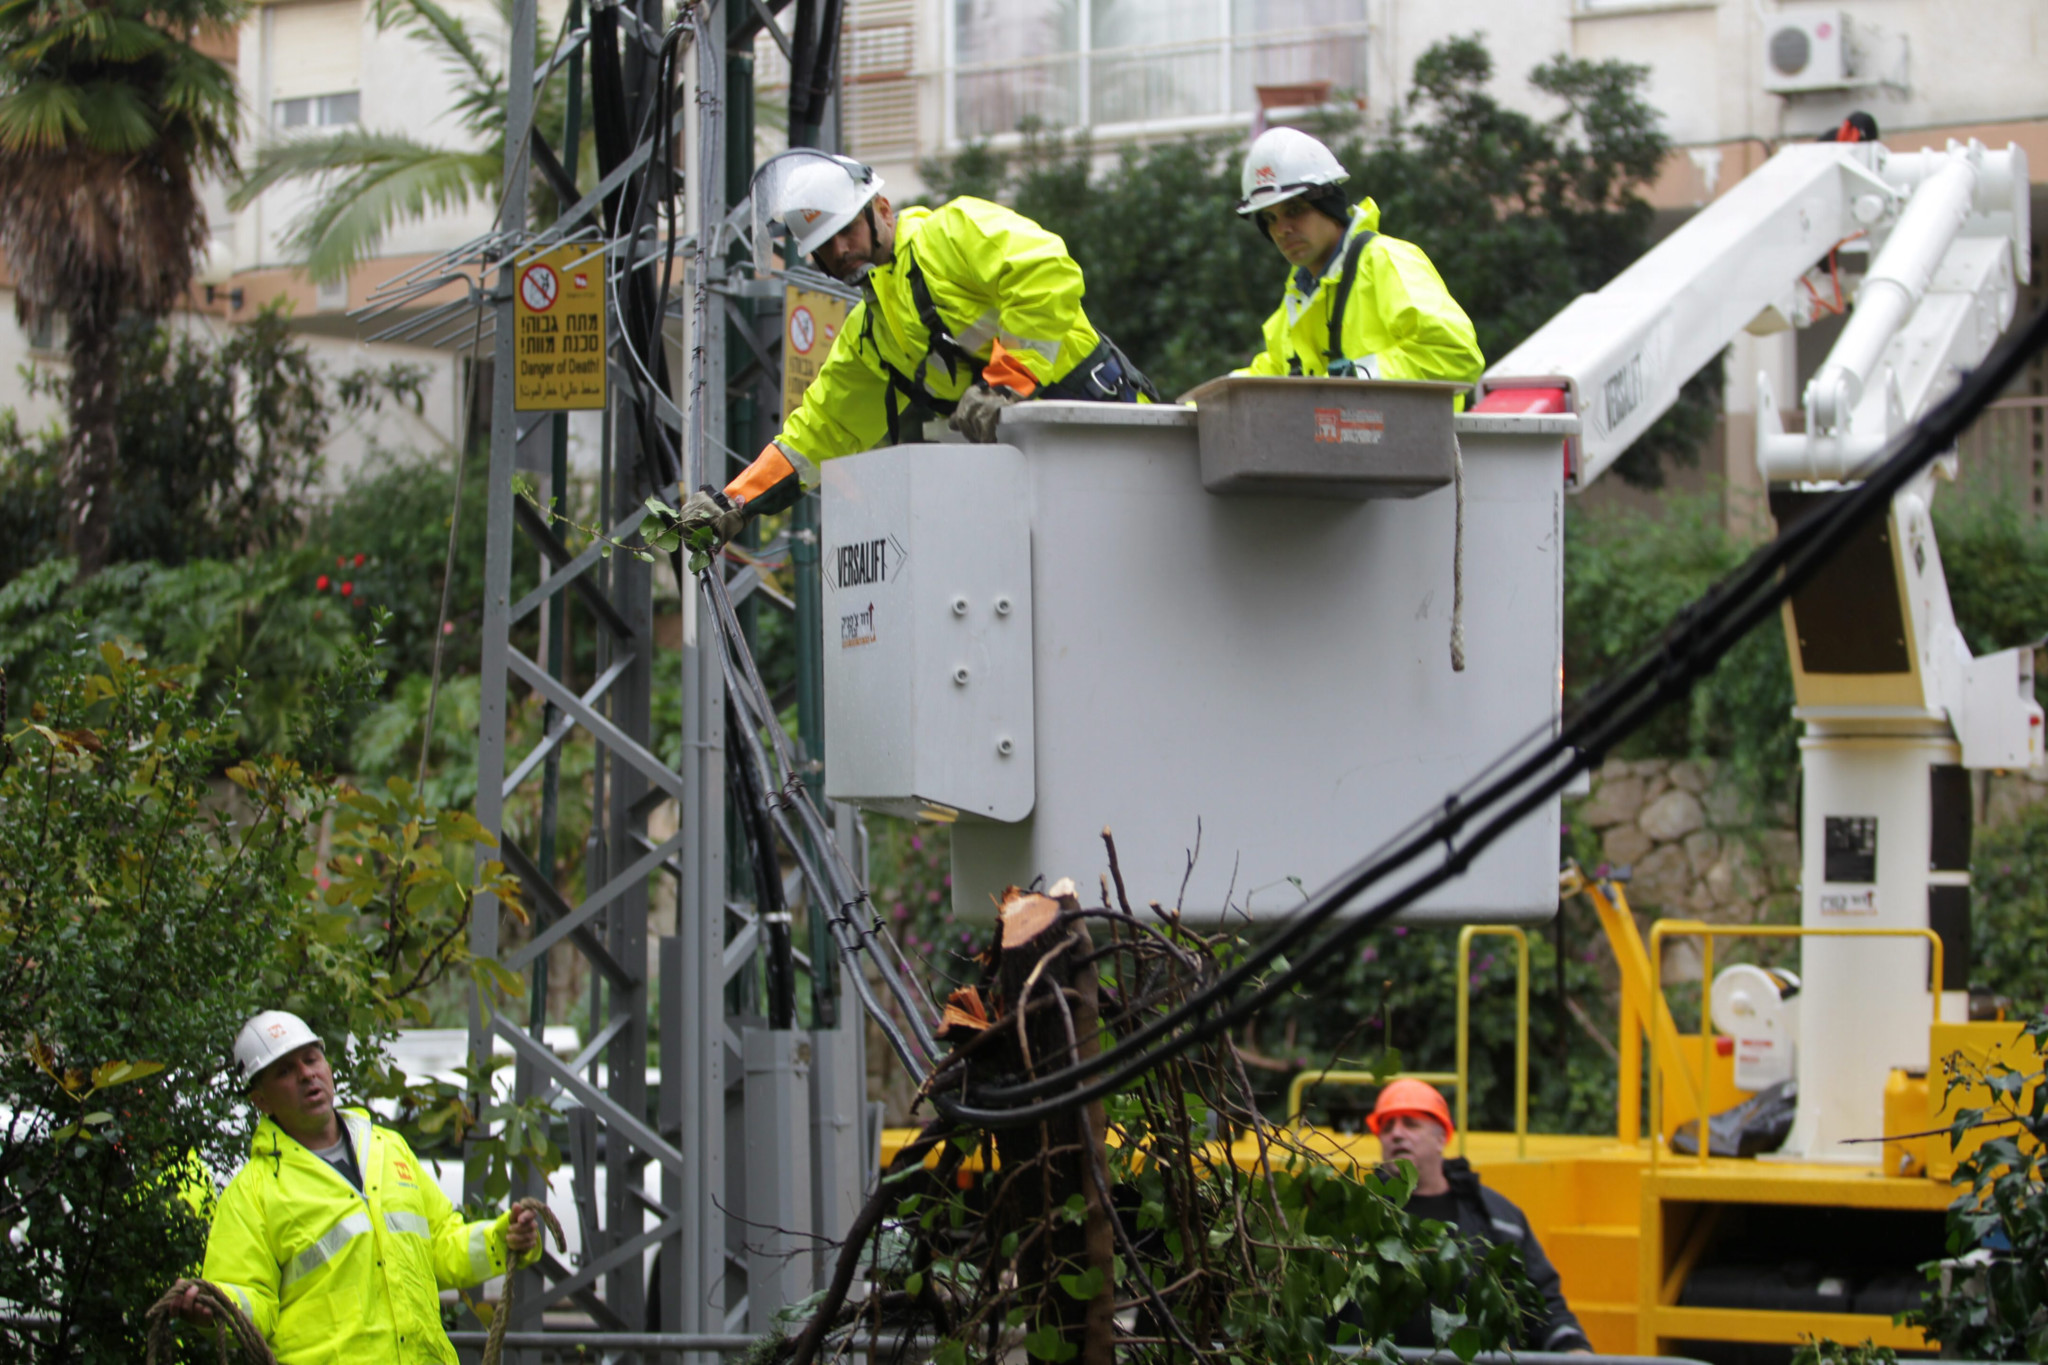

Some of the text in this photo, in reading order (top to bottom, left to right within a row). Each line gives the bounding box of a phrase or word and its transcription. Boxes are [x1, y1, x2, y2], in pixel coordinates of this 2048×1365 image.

[521, 313, 598, 334] מתח גבוה!
[520, 334, 599, 355] סכנת מוות!
[521, 356, 600, 379] Danger of Death!
[837, 538, 886, 589] VERSALIFT
